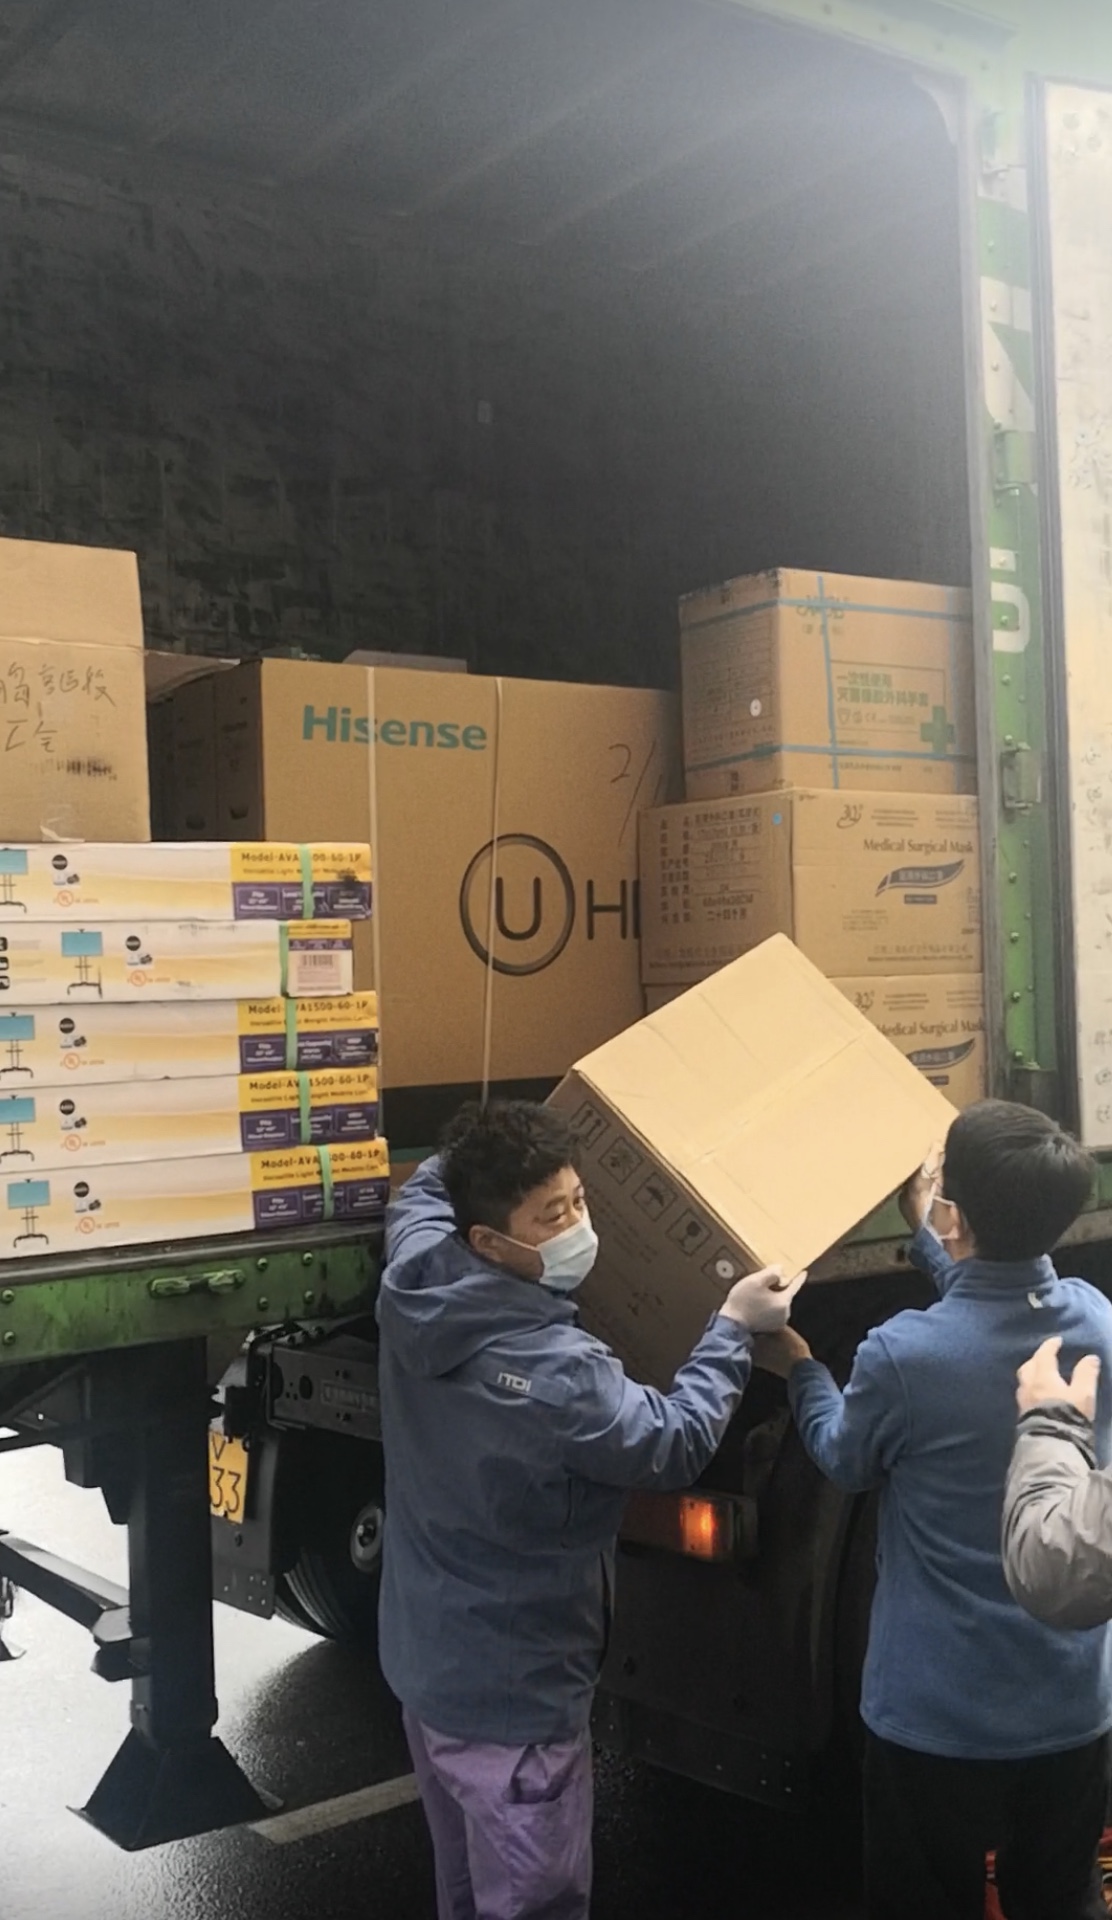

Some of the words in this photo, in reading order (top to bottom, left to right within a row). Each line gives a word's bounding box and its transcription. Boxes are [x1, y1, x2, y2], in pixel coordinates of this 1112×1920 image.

[302, 704, 487, 751] Hisense
[863, 838, 905, 852] Medical
[907, 839, 948, 856] Surgical
[950, 840, 974, 853] Mask
[919, 1018, 958, 1037] Surgical
[960, 1016, 986, 1032] Mask
[210, 1464, 242, 1514] 33
